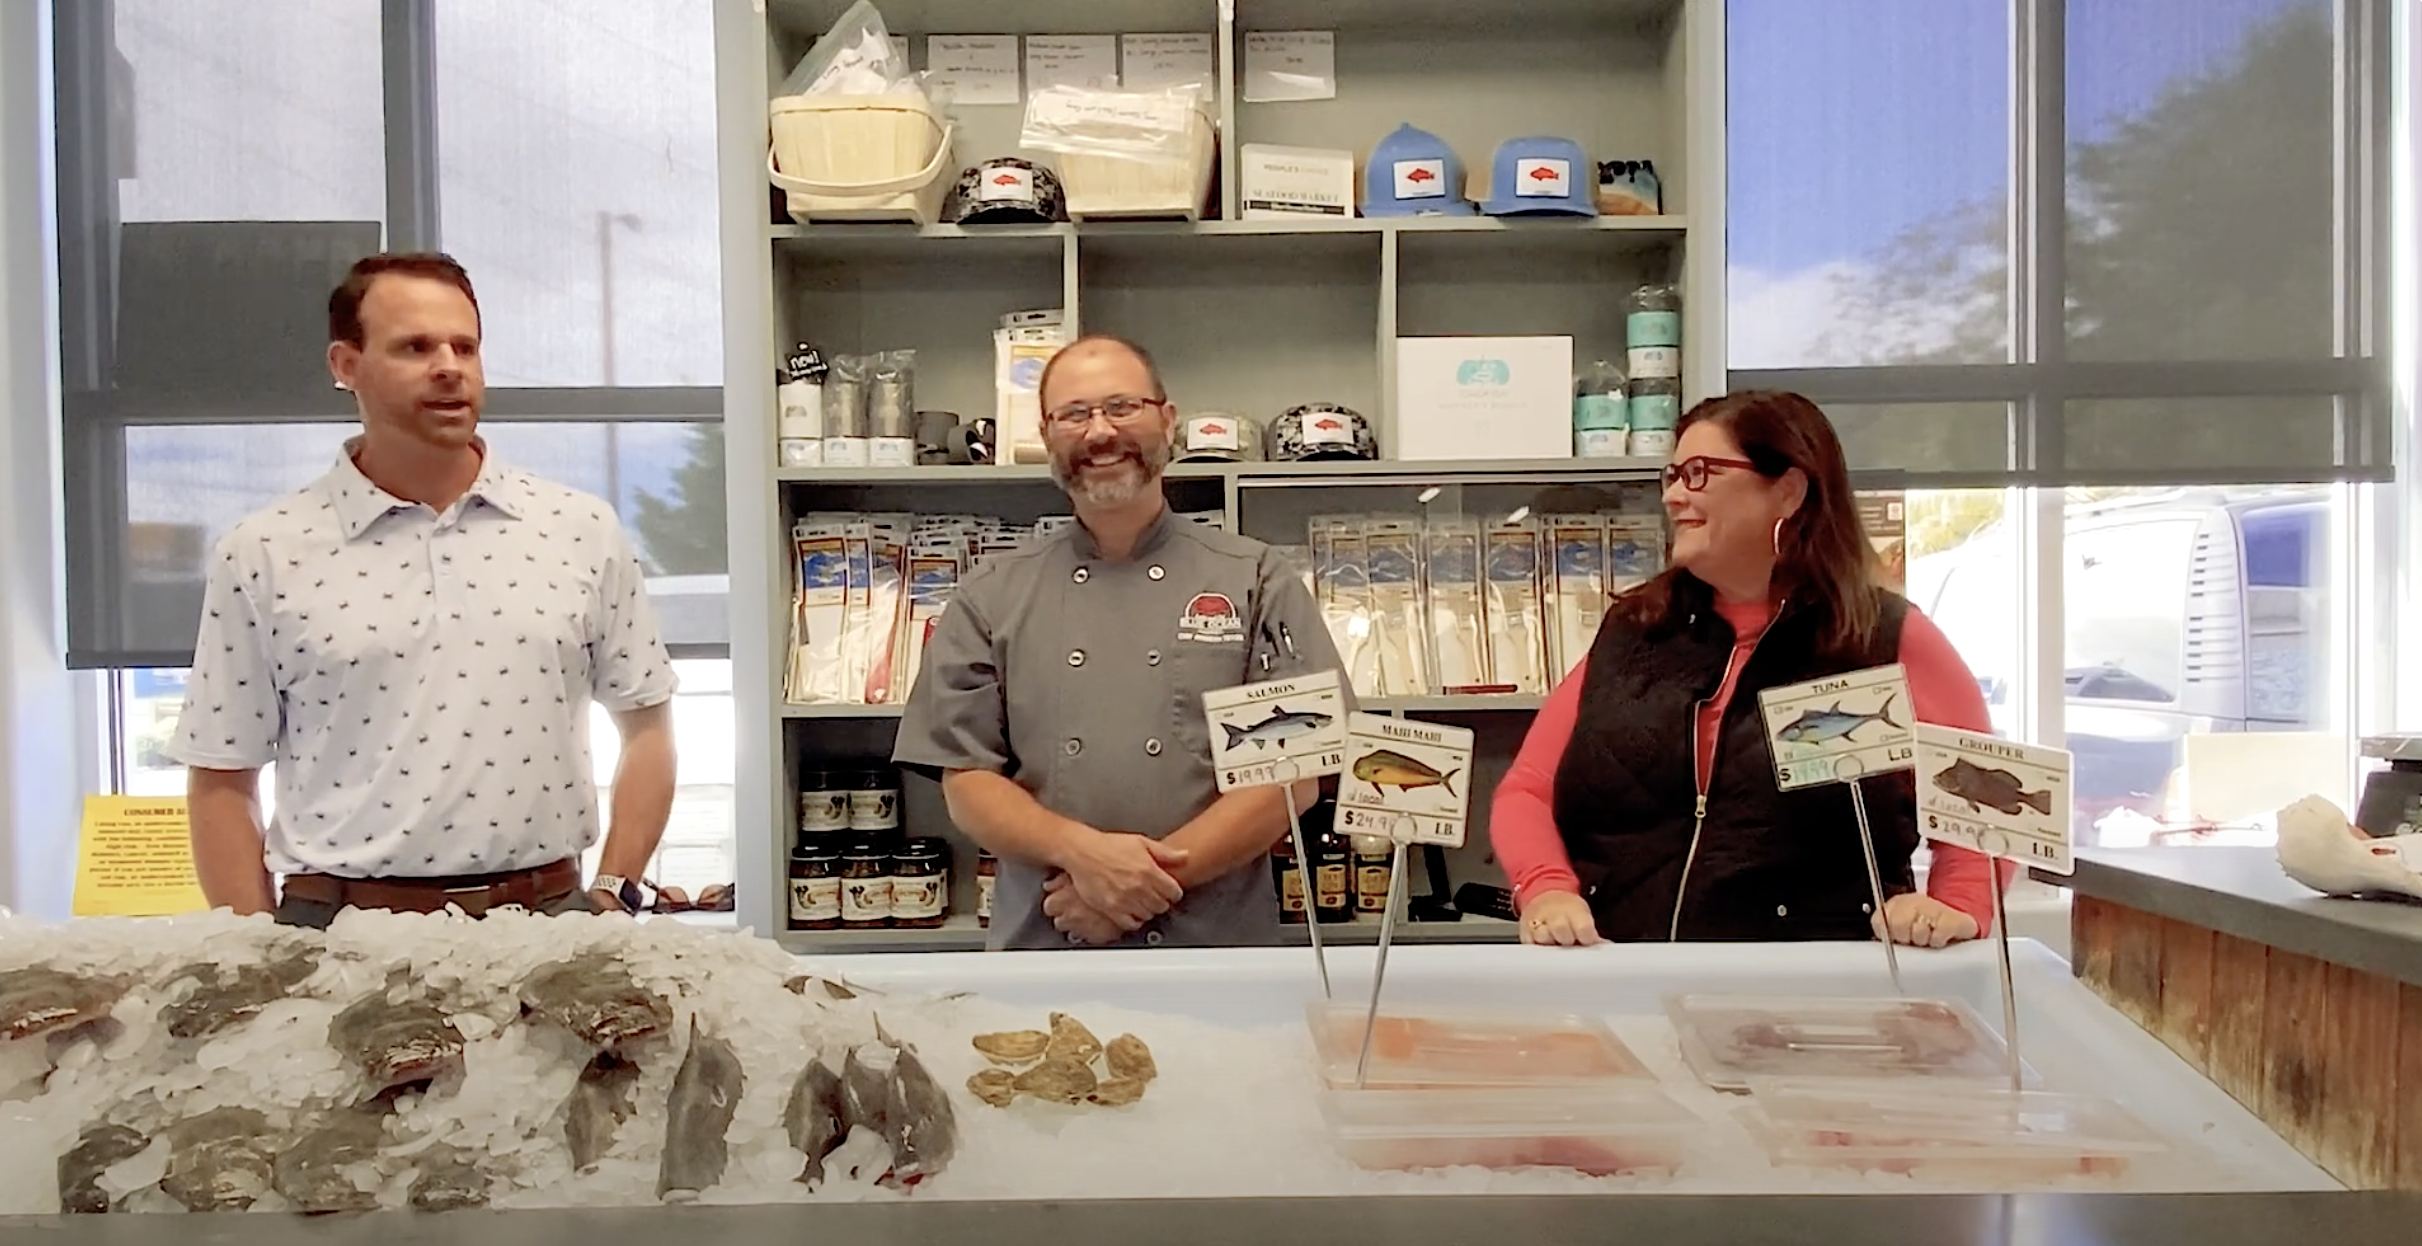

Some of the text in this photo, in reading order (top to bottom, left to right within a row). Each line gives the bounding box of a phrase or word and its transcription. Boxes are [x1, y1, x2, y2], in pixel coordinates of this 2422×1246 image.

[1247, 684, 1296, 699] SALMON
[1811, 679, 1849, 695] TUNA
[1382, 724, 1442, 743] MAHI MAHI
[1887, 747, 1912, 762] LB
[1959, 737, 2024, 760] GROUPER
[124, 808, 173, 817] CONSUMER
